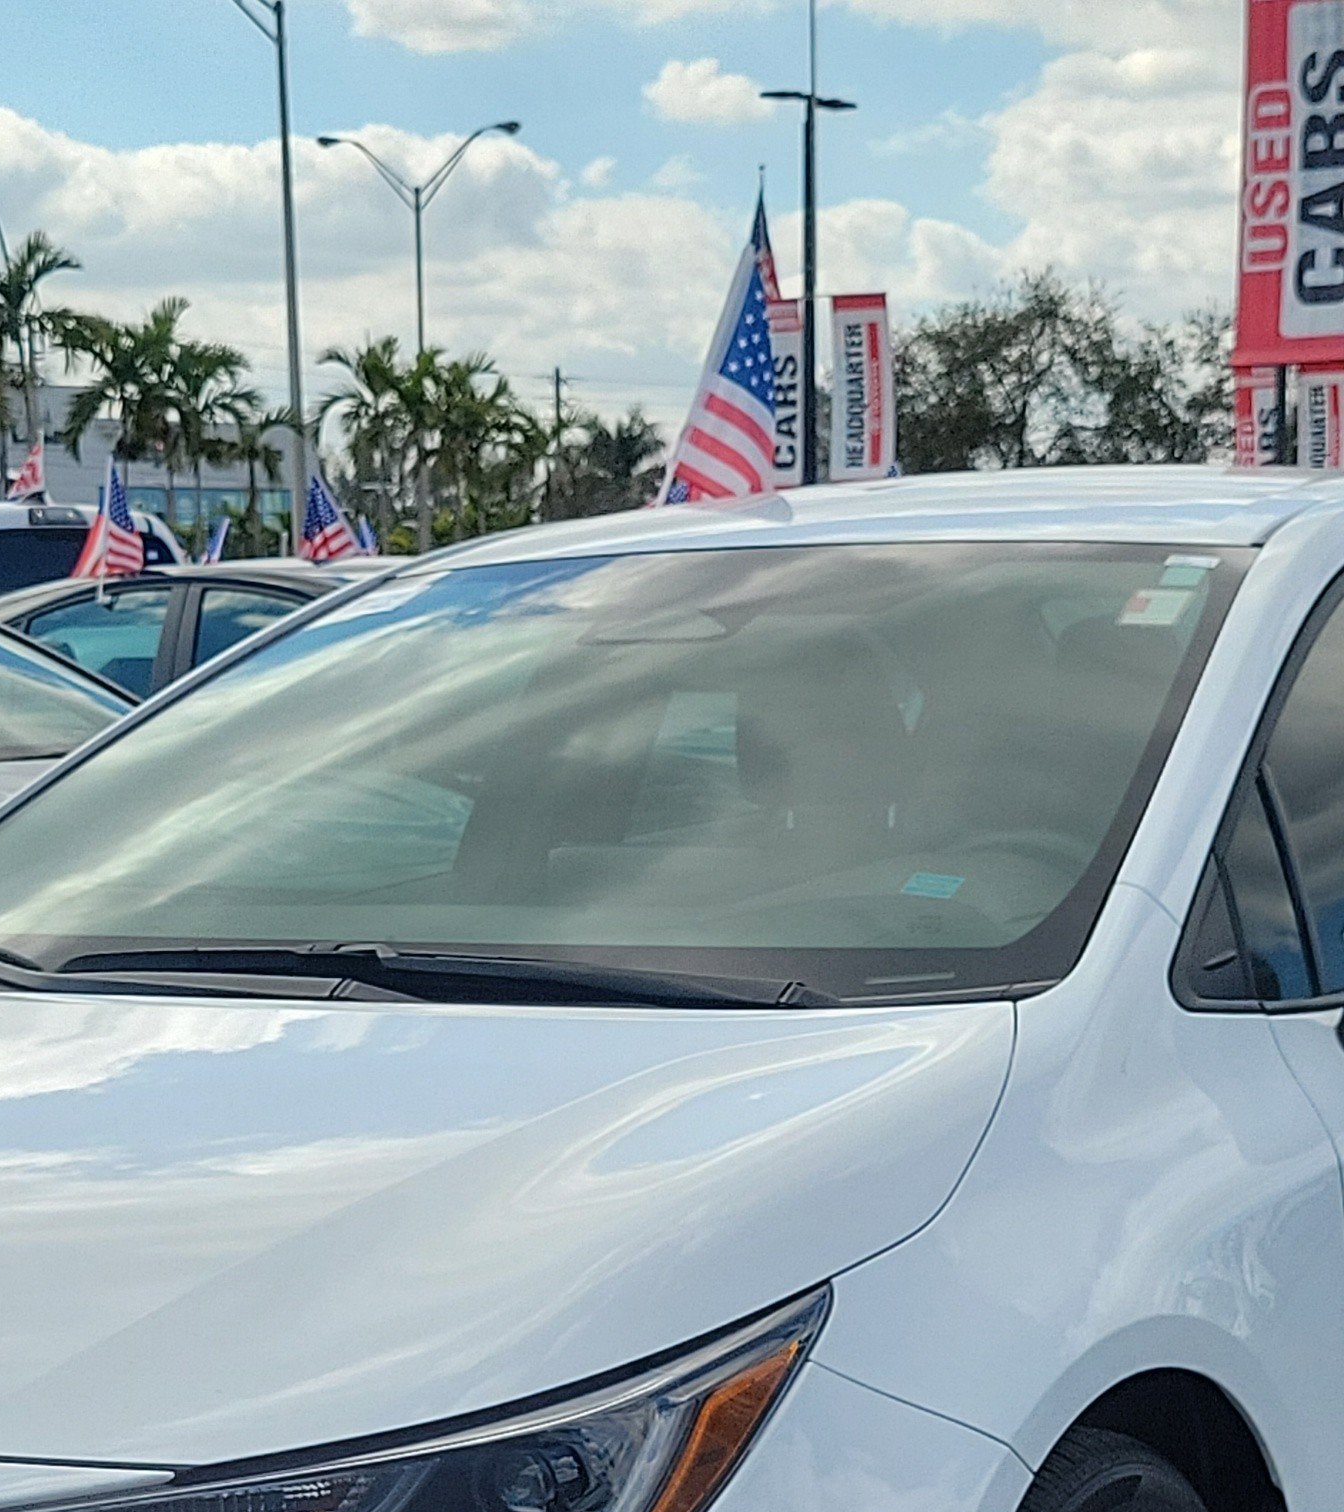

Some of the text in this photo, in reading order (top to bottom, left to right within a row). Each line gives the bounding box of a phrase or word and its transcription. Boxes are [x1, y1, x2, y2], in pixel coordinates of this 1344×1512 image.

[1245, 86, 1292, 270] USED
[773, 354, 798, 470] CARS
[844, 322, 867, 469] HEADQUARTER
